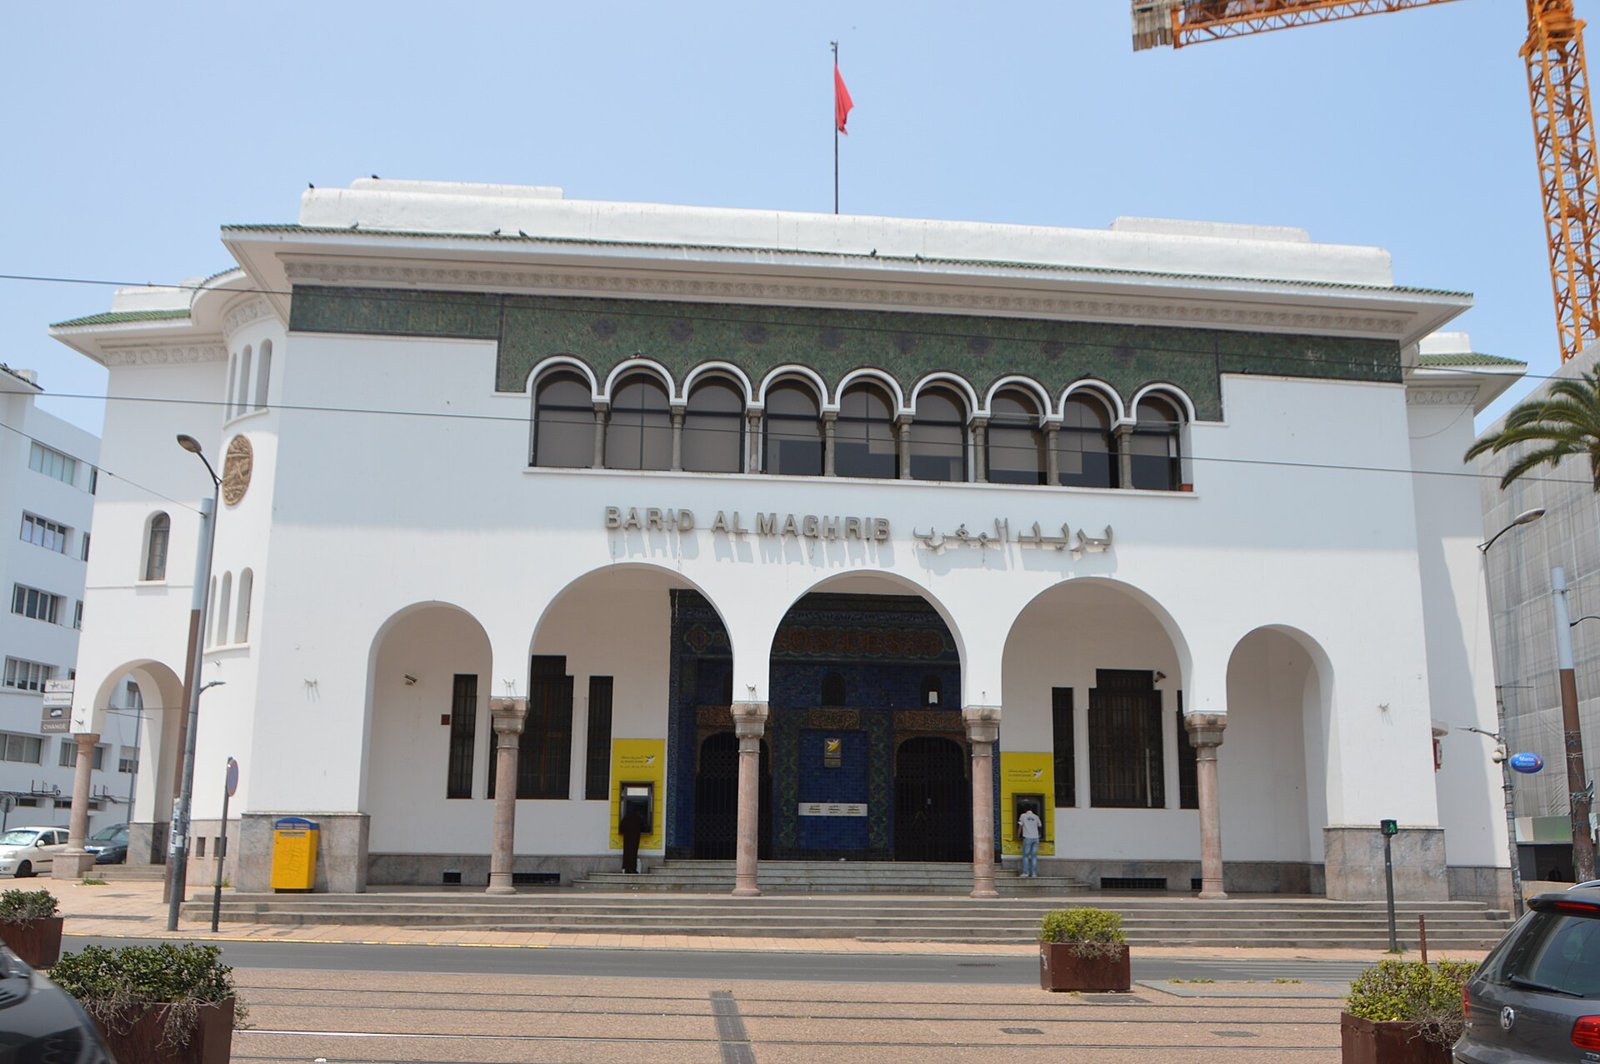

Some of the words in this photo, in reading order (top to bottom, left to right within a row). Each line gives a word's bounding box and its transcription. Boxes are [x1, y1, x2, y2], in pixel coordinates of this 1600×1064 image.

[605, 506, 695, 532] BARID
[756, 512, 891, 541] MAGHRIB
[912, 517, 1009, 551] المغرب
[1018, 520, 1114, 553] بريد
